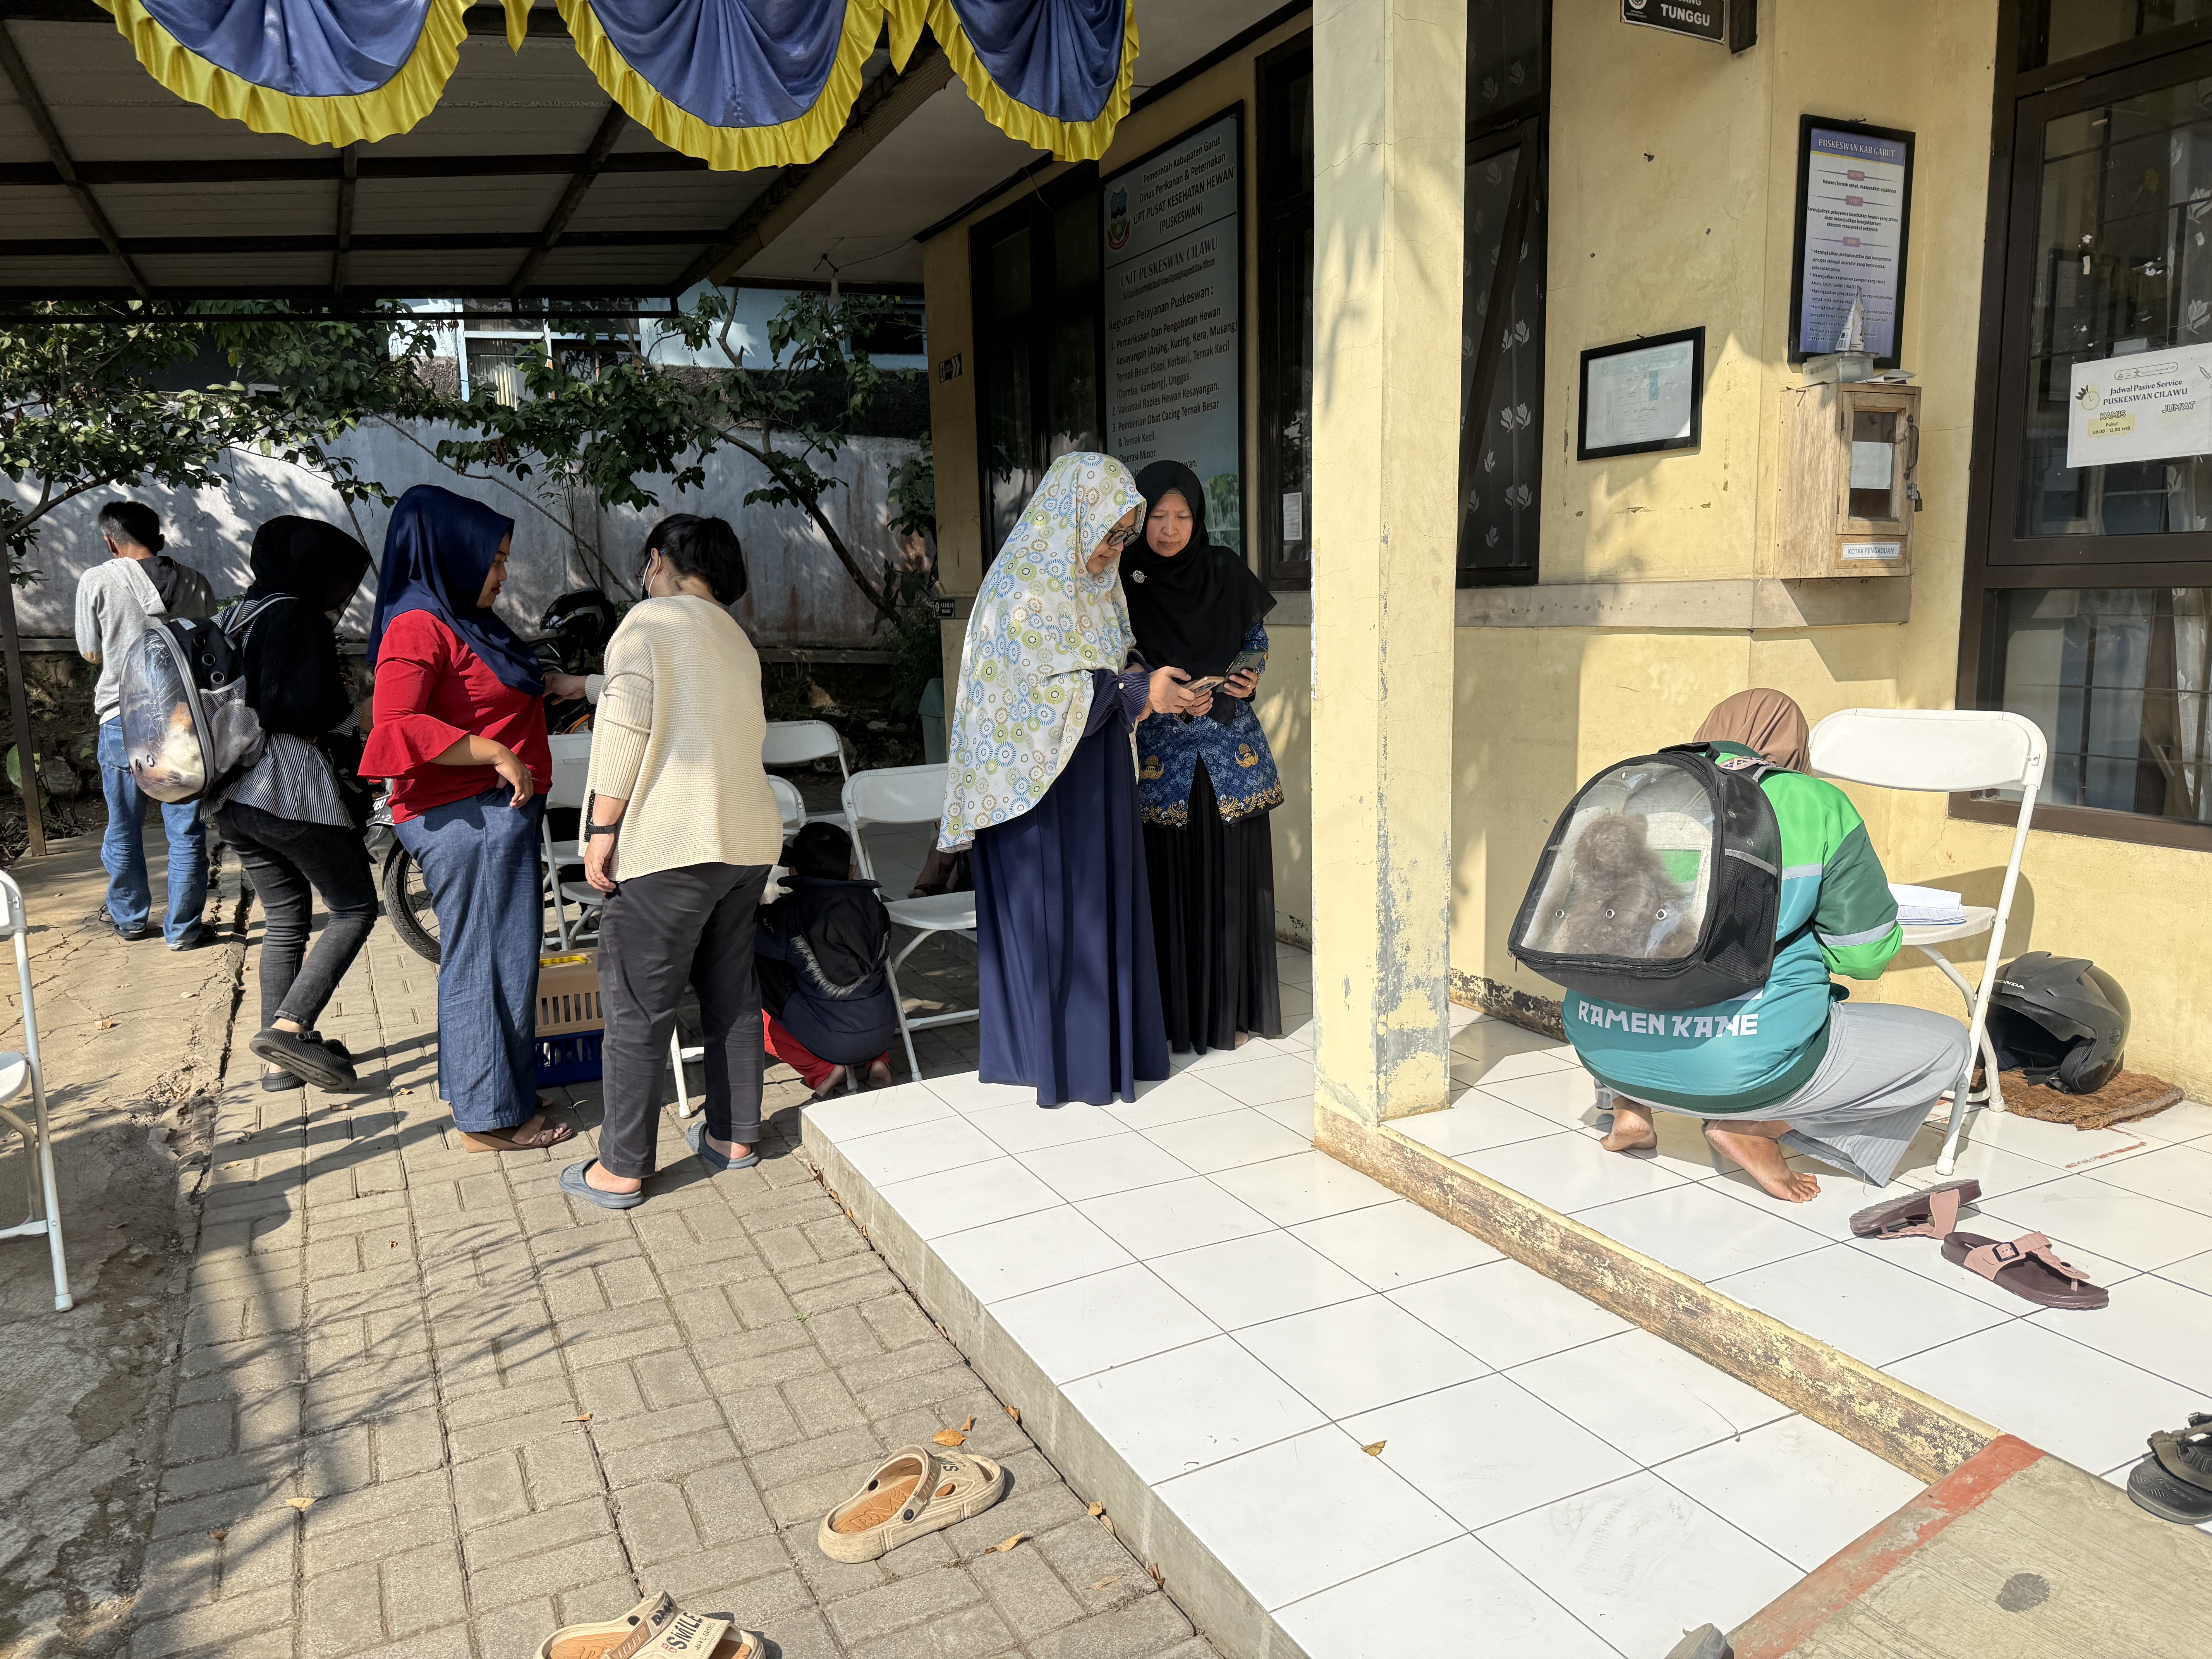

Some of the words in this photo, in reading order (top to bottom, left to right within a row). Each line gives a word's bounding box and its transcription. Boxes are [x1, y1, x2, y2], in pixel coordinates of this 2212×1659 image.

[1661, 3, 1710, 26] TUNGGU
[1144, 161, 1172, 185] Pemerintah
[1173, 146, 1202, 167] Kabupaten
[1204, 136, 1220, 152] Garut
[1819, 138, 1858, 152] PUSKESWAN
[1859, 144, 1872, 154] KAB
[1874, 148, 1895, 157] GARUT
[1140, 190, 1154, 203] Dinas
[1156, 175, 1183, 196] Perikanan
[1185, 170, 1189, 181] &
[1191, 153, 1225, 177] Peternakan
[1133, 210, 1145, 225] UPT
[1147, 200, 1166, 218] PUSAT
[1168, 180, 1204, 210] KESEHATAN
[1207, 167, 1233, 190] HEWAN
[1160, 201, 1203, 234] (PUSKESWAN)
[1121, 270, 1137, 288] UNIT
[1139, 251, 1184, 281] PUSKESWAN
[1187, 236, 1217, 261] CILAWU
[1109, 315, 1135, 332] Kegiatan
[1137, 302, 1169, 321] Pelayanan
[1171, 287, 1209, 309] Puskeswan
[1111, 342, 1115, 351] 1.
[1117, 331, 1150, 349] Pemeriksaan
[1151, 328, 1162, 338] Dan
[1163, 316, 1197, 334] Pengobatan
[1199, 307, 1220, 322] Hewan
[1116, 350, 1147, 366] Kesayangan
[1148, 342, 1169, 359] (Anjing,
[1170, 336, 1191, 349] Kucing,
[1193, 331, 1208, 343] Kera,
[1210, 318, 1238, 337] Musang)
[1116, 367, 1133, 382] Ternak
[1135, 366, 1149, 378] Besar
[1151, 360, 1166, 375] (Sapi,
[1168, 351, 1192, 368] Kerbau),
[1193, 347, 1213, 361] Ternak
[1215, 340, 1230, 354] Kecil
[1112, 407, 1116, 416] 2.
[1118, 400, 1141, 415] Vaksinasi
[1143, 397, 1160, 409] Rabies
[1162, 391, 1181, 404] Hewan
[1183, 382, 1219, 399] Kesayangan.
[1117, 387, 1139, 400] (Domba,
[1140, 376, 1167, 393] Kambing),
[1169, 372, 1191, 386] Unggas.
[2103, 393, 2152, 405] PUSKESWAN
[2154, 388, 2188, 398] CILAWU
[2109, 385, 2132, 396] Jadwal
[2156, 380, 2183, 388] Service
[1112, 423, 1117, 433] 3.
[1118, 417, 1146, 431] Pemberian
[1147, 414, 1160, 425] Obat
[1162, 409, 1180, 421] Cacing
[1181, 403, 1200, 417] Ternak
[1202, 400, 1219, 412] Besar
[2099, 410, 2126, 420] KAMIS
[2162, 401, 2196, 413] JUM'AT
[1118, 438, 1122, 447] &
[1124, 433, 1141, 447] Ternak
[1142, 431, 1156, 443] Kecil.
[1119, 451, 1139, 464] Operasi
[1140, 448, 1157, 460] Minor.
[1578, 1000, 1665, 1036] RAMEN
[666, 1611, 704, 1650] SMILE
[695, 1637, 705, 1651] MAKE
[704, 1622, 715, 1638] SHOES
